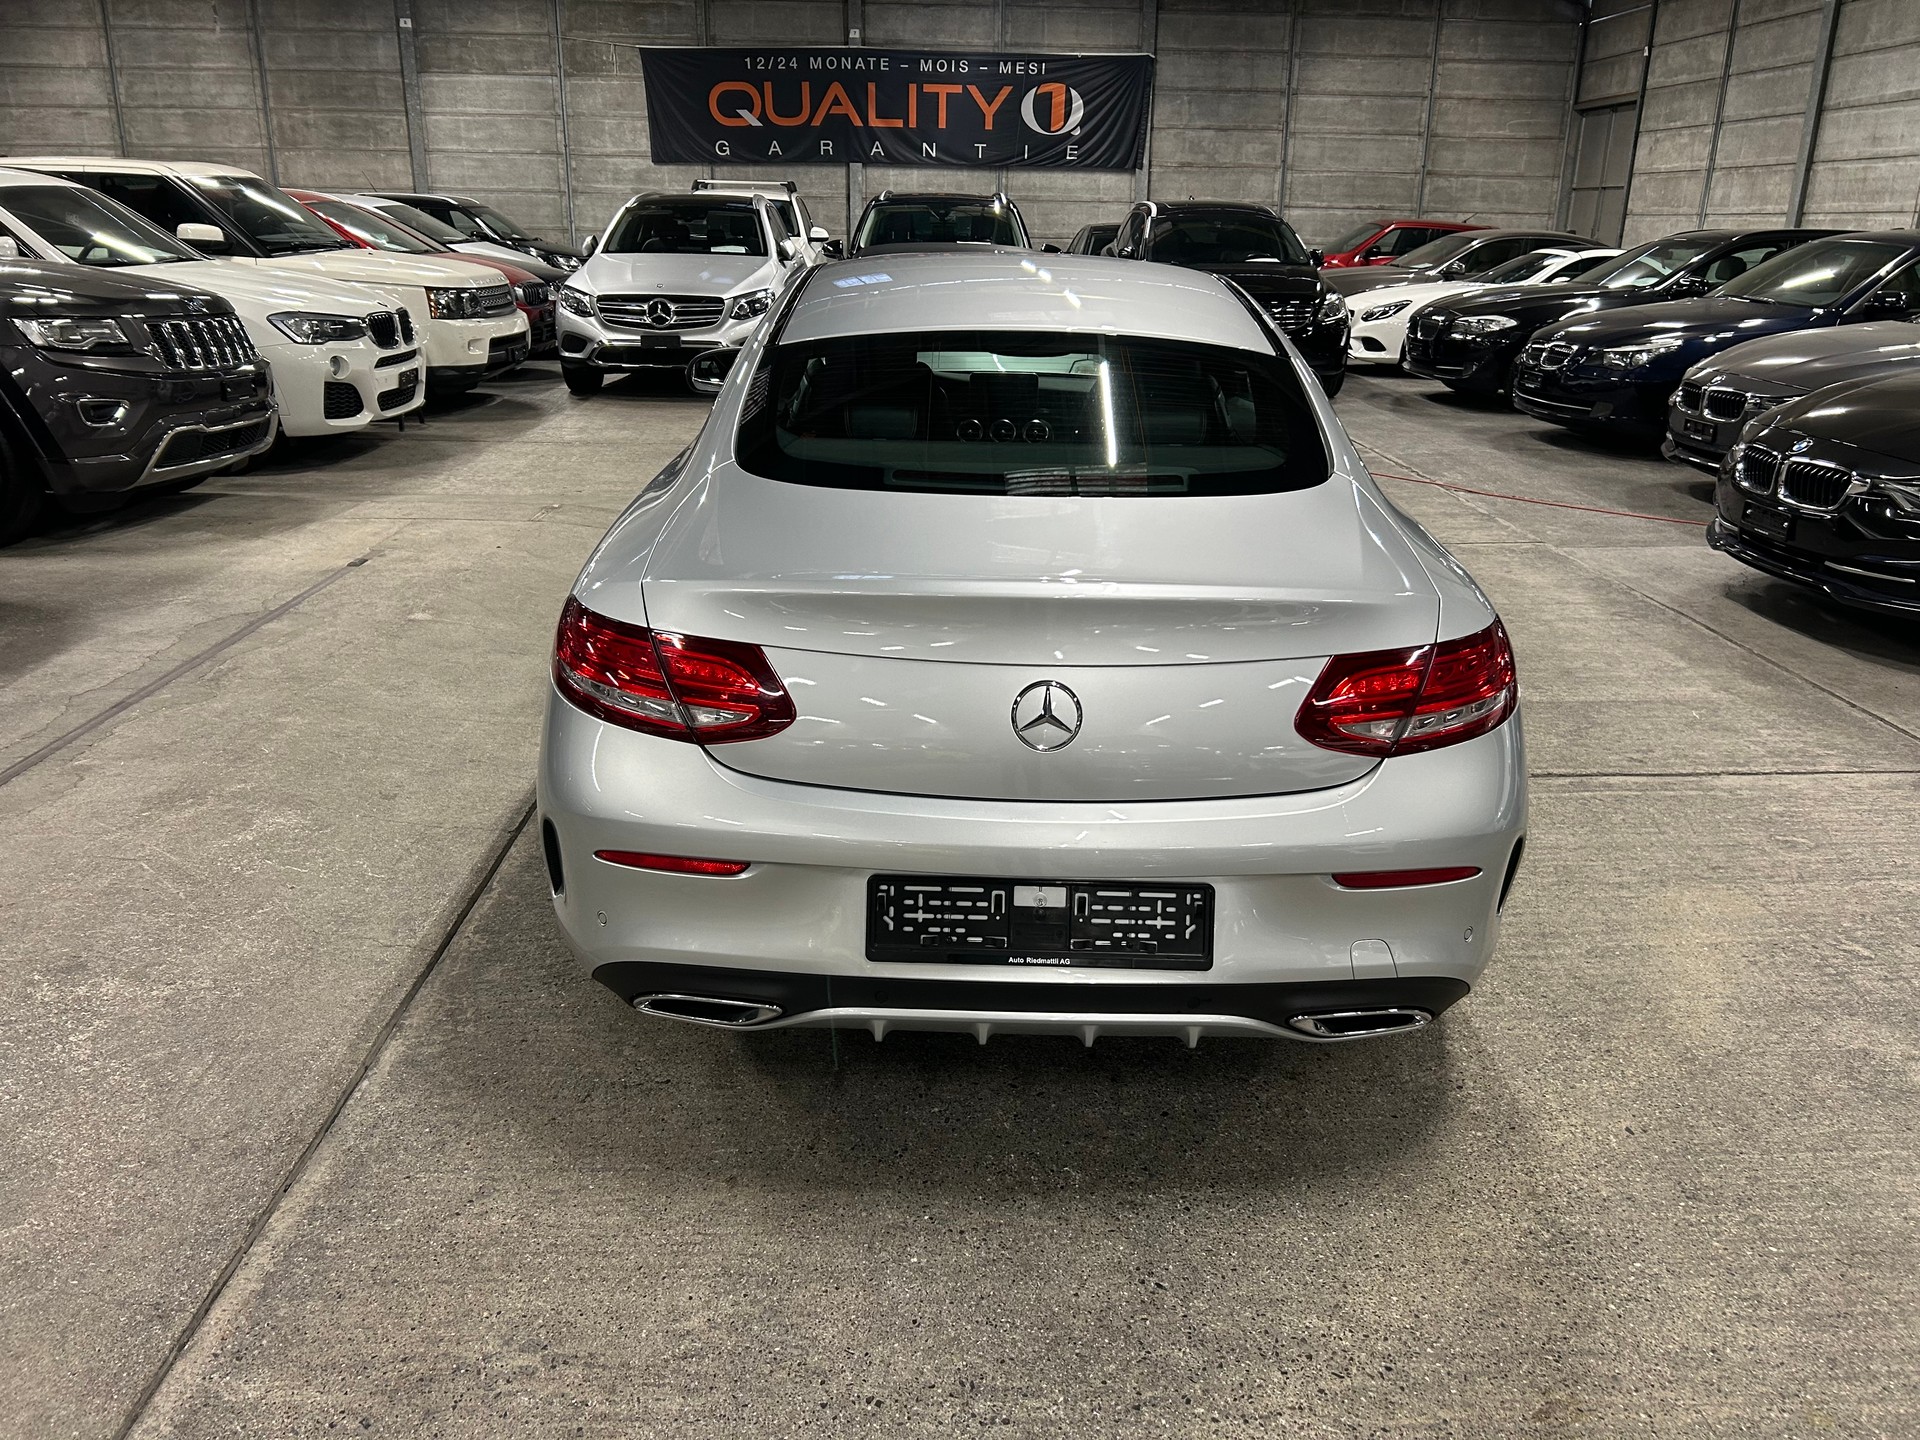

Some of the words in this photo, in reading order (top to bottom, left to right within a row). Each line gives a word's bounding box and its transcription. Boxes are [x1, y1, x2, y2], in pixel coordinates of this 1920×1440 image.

[744, 56, 798, 70] 12/24
[809, 56, 890, 71] MONATE
[920, 59, 969, 73] MOIS
[999, 61, 1046, 75] MESI
[708, 81, 1013, 130] QUALITY
[715, 140, 1078, 160] GARANTIE
